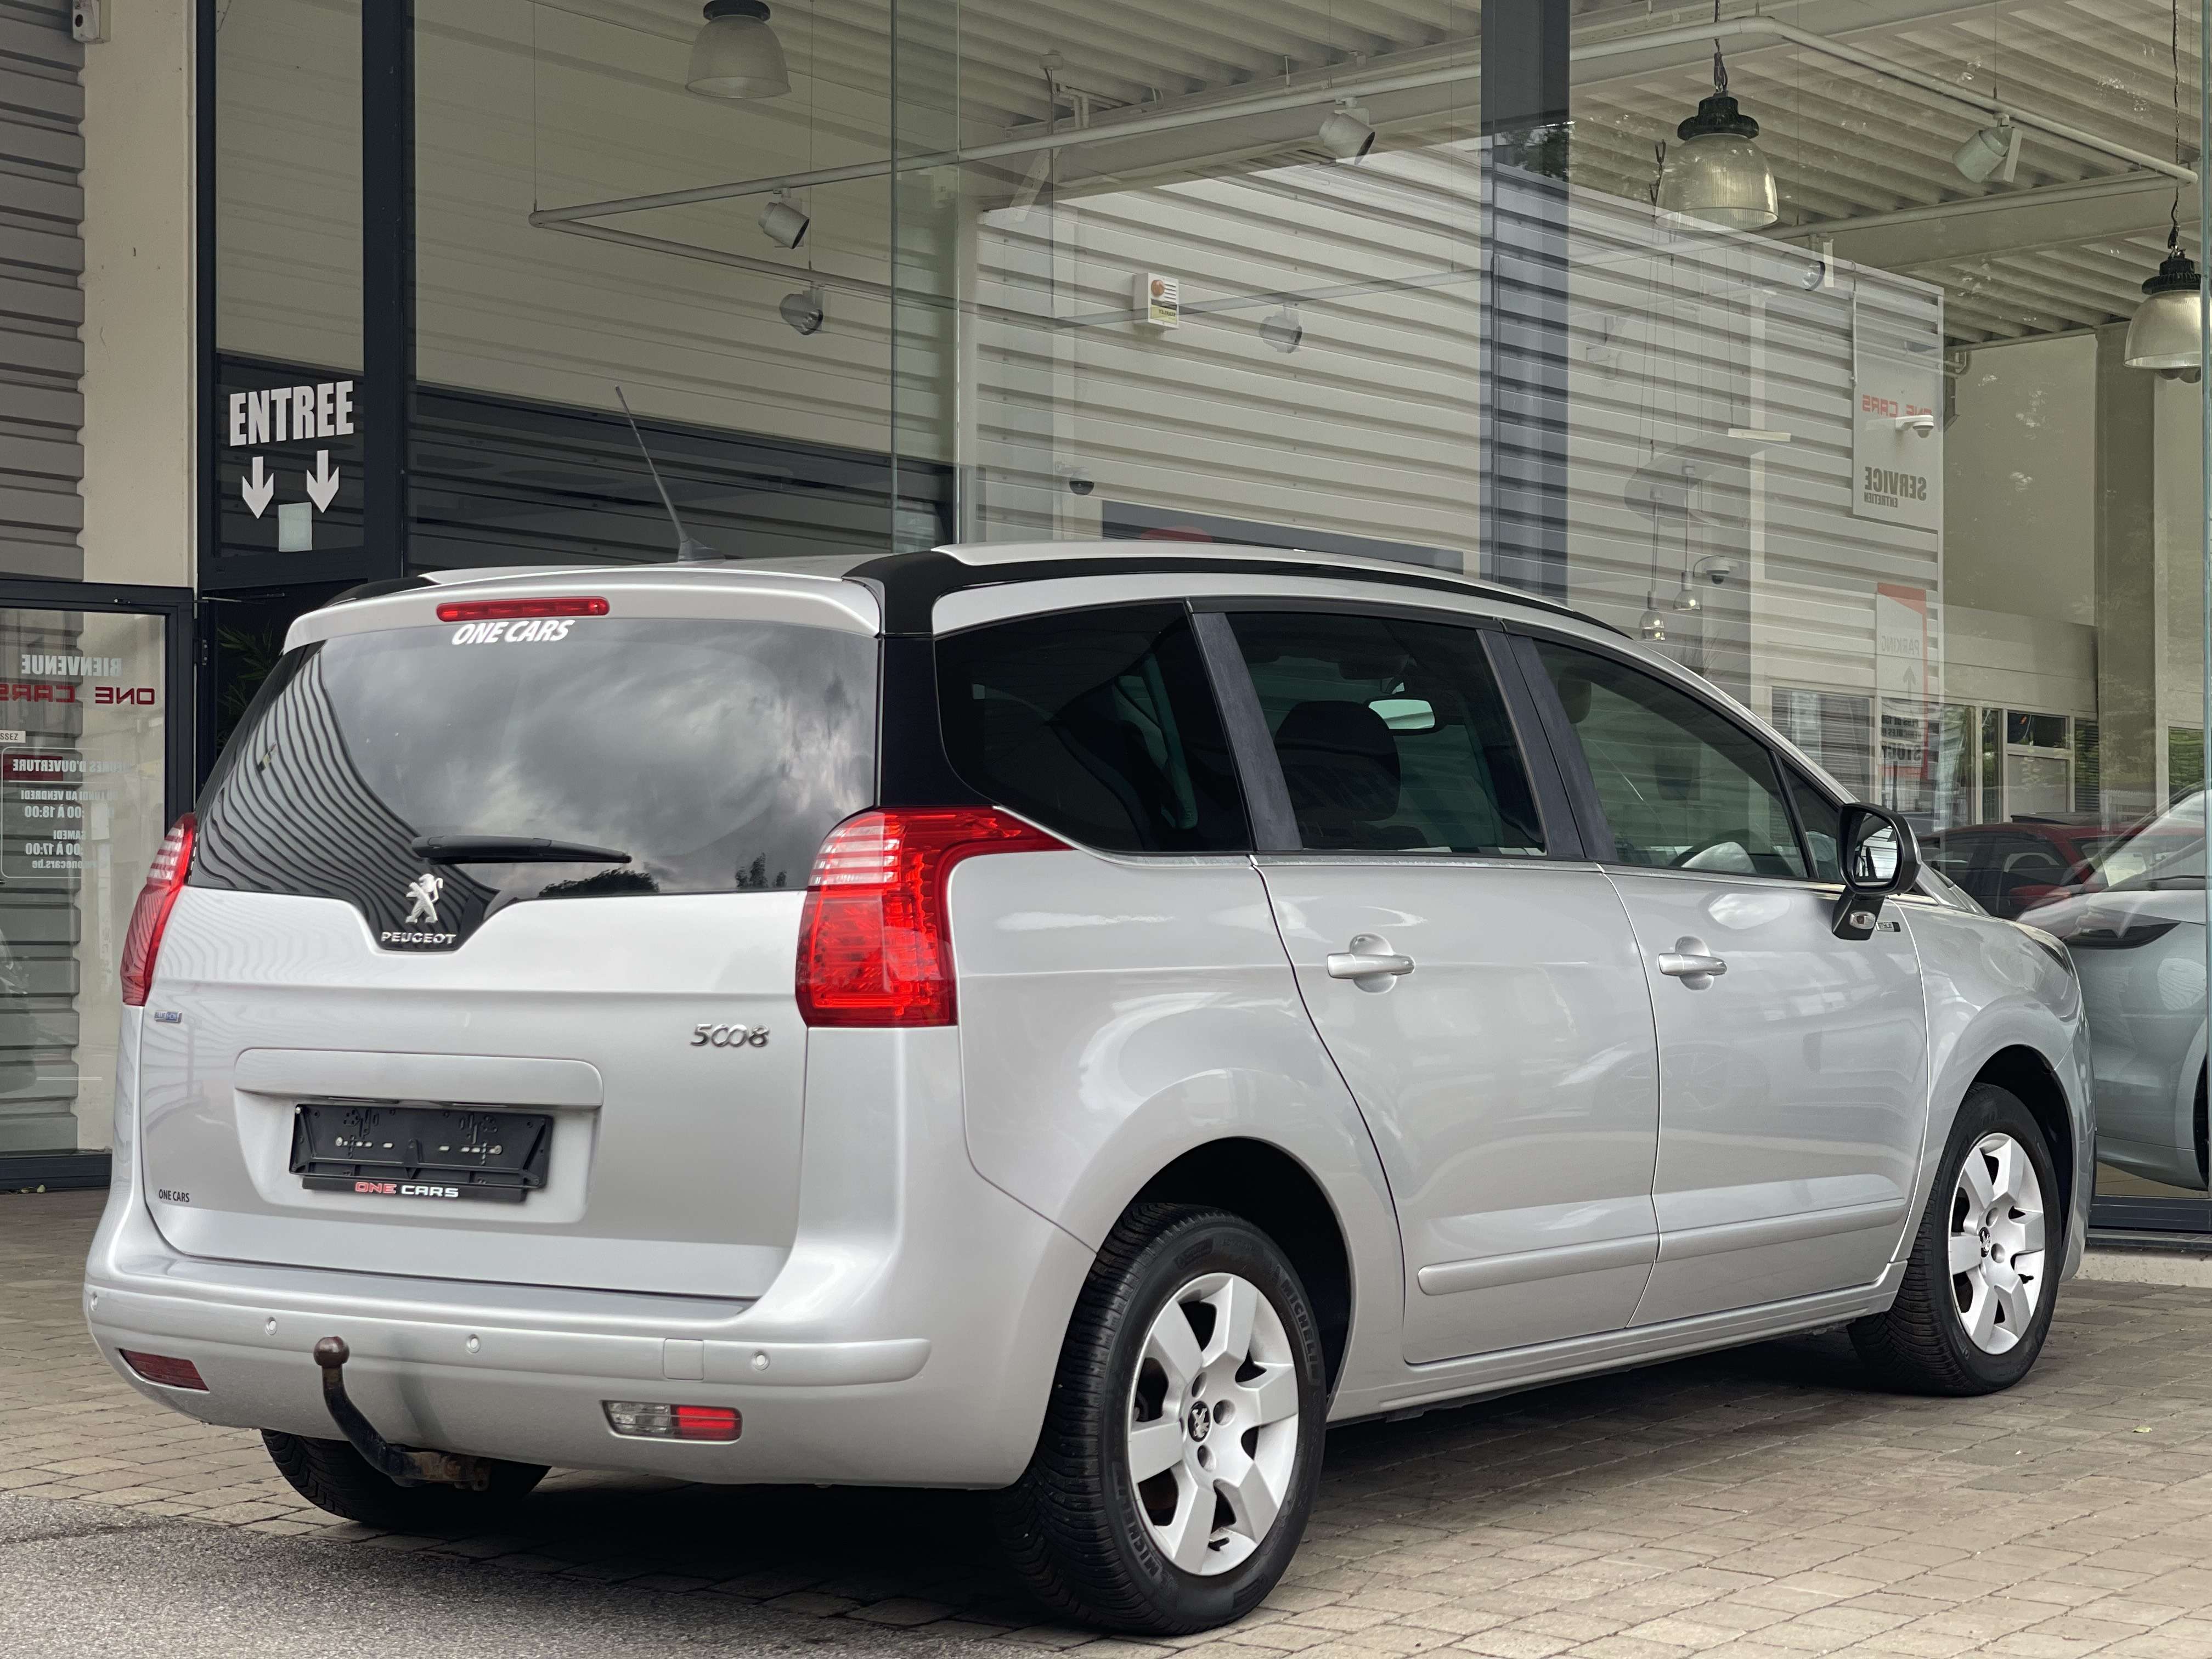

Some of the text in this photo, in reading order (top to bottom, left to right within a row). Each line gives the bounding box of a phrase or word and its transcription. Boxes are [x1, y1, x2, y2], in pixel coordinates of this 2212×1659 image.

[230, 380, 354, 447] ENTREE
[451, 619, 575, 646] ONE CARS
[0, 732, 18, 741] SSEZ
[381, 932, 456, 944] PEUGEOT
[691, 1023, 769, 1047] 5008
[159, 1189, 190, 1203] ONE CARS
[355, 1182, 459, 1198] ONE CARS
